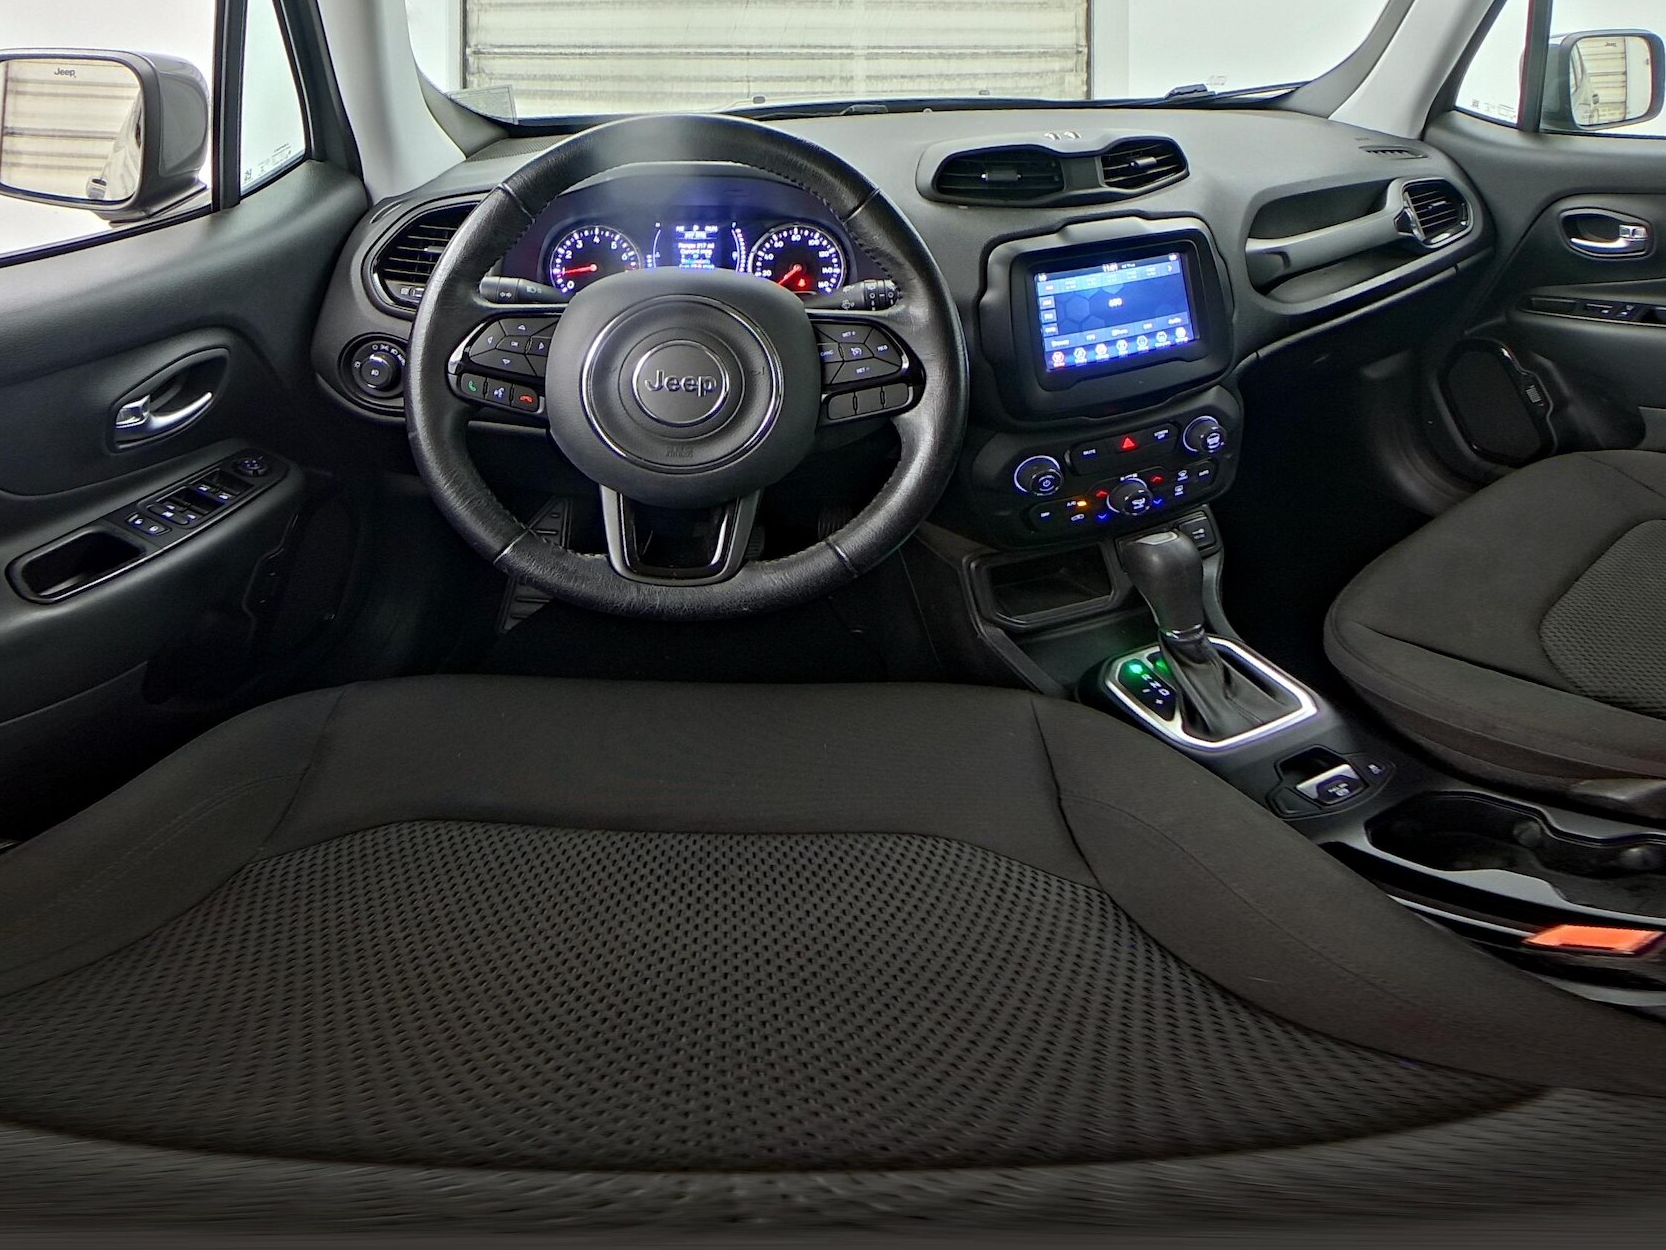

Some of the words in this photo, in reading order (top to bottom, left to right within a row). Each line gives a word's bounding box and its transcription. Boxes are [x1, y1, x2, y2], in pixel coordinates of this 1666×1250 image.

[576, 240, 583, 248] 3
[611, 241, 617, 249] 5
[565, 250, 572, 259] 2
[621, 253, 628, 261] 6
[762, 269, 772, 277] 20
[567, 280, 575, 289] 0
[644, 369, 717, 397] Jeep
[1158, 688, 1170, 696] D
